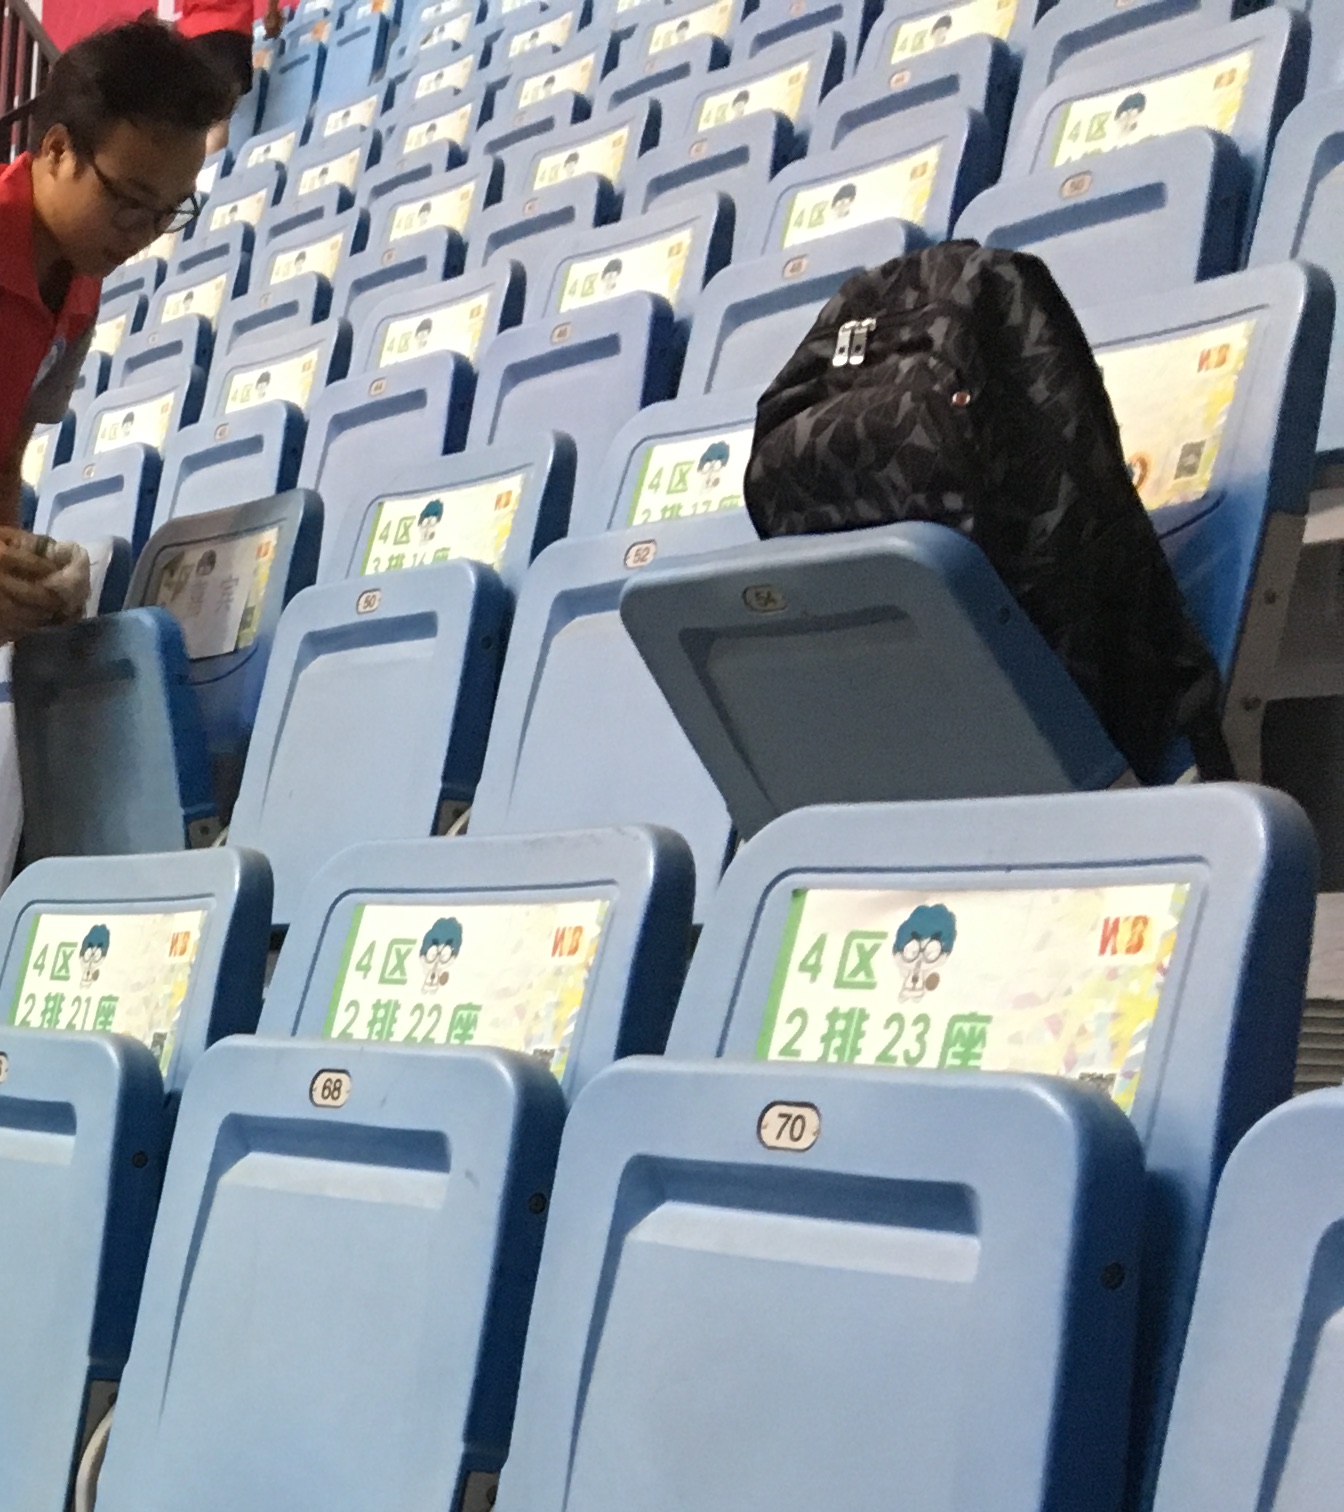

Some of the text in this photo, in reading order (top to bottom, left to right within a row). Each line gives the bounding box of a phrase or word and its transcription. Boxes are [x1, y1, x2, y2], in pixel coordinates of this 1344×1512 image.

[648, 460, 695, 494] 4区
[379, 515, 416, 546] 4区
[632, 549, 650, 564] 52
[33, 941, 78, 981] 4区
[356, 937, 417, 985] 4区
[798, 930, 888, 990] 4区
[20, 992, 119, 1032] 2排21座
[337, 999, 483, 1044] 2排22座
[778, 1005, 993, 1070] 2排23座
[321, 1077, 342, 1101] 68
[775, 1113, 806, 1141] 70
